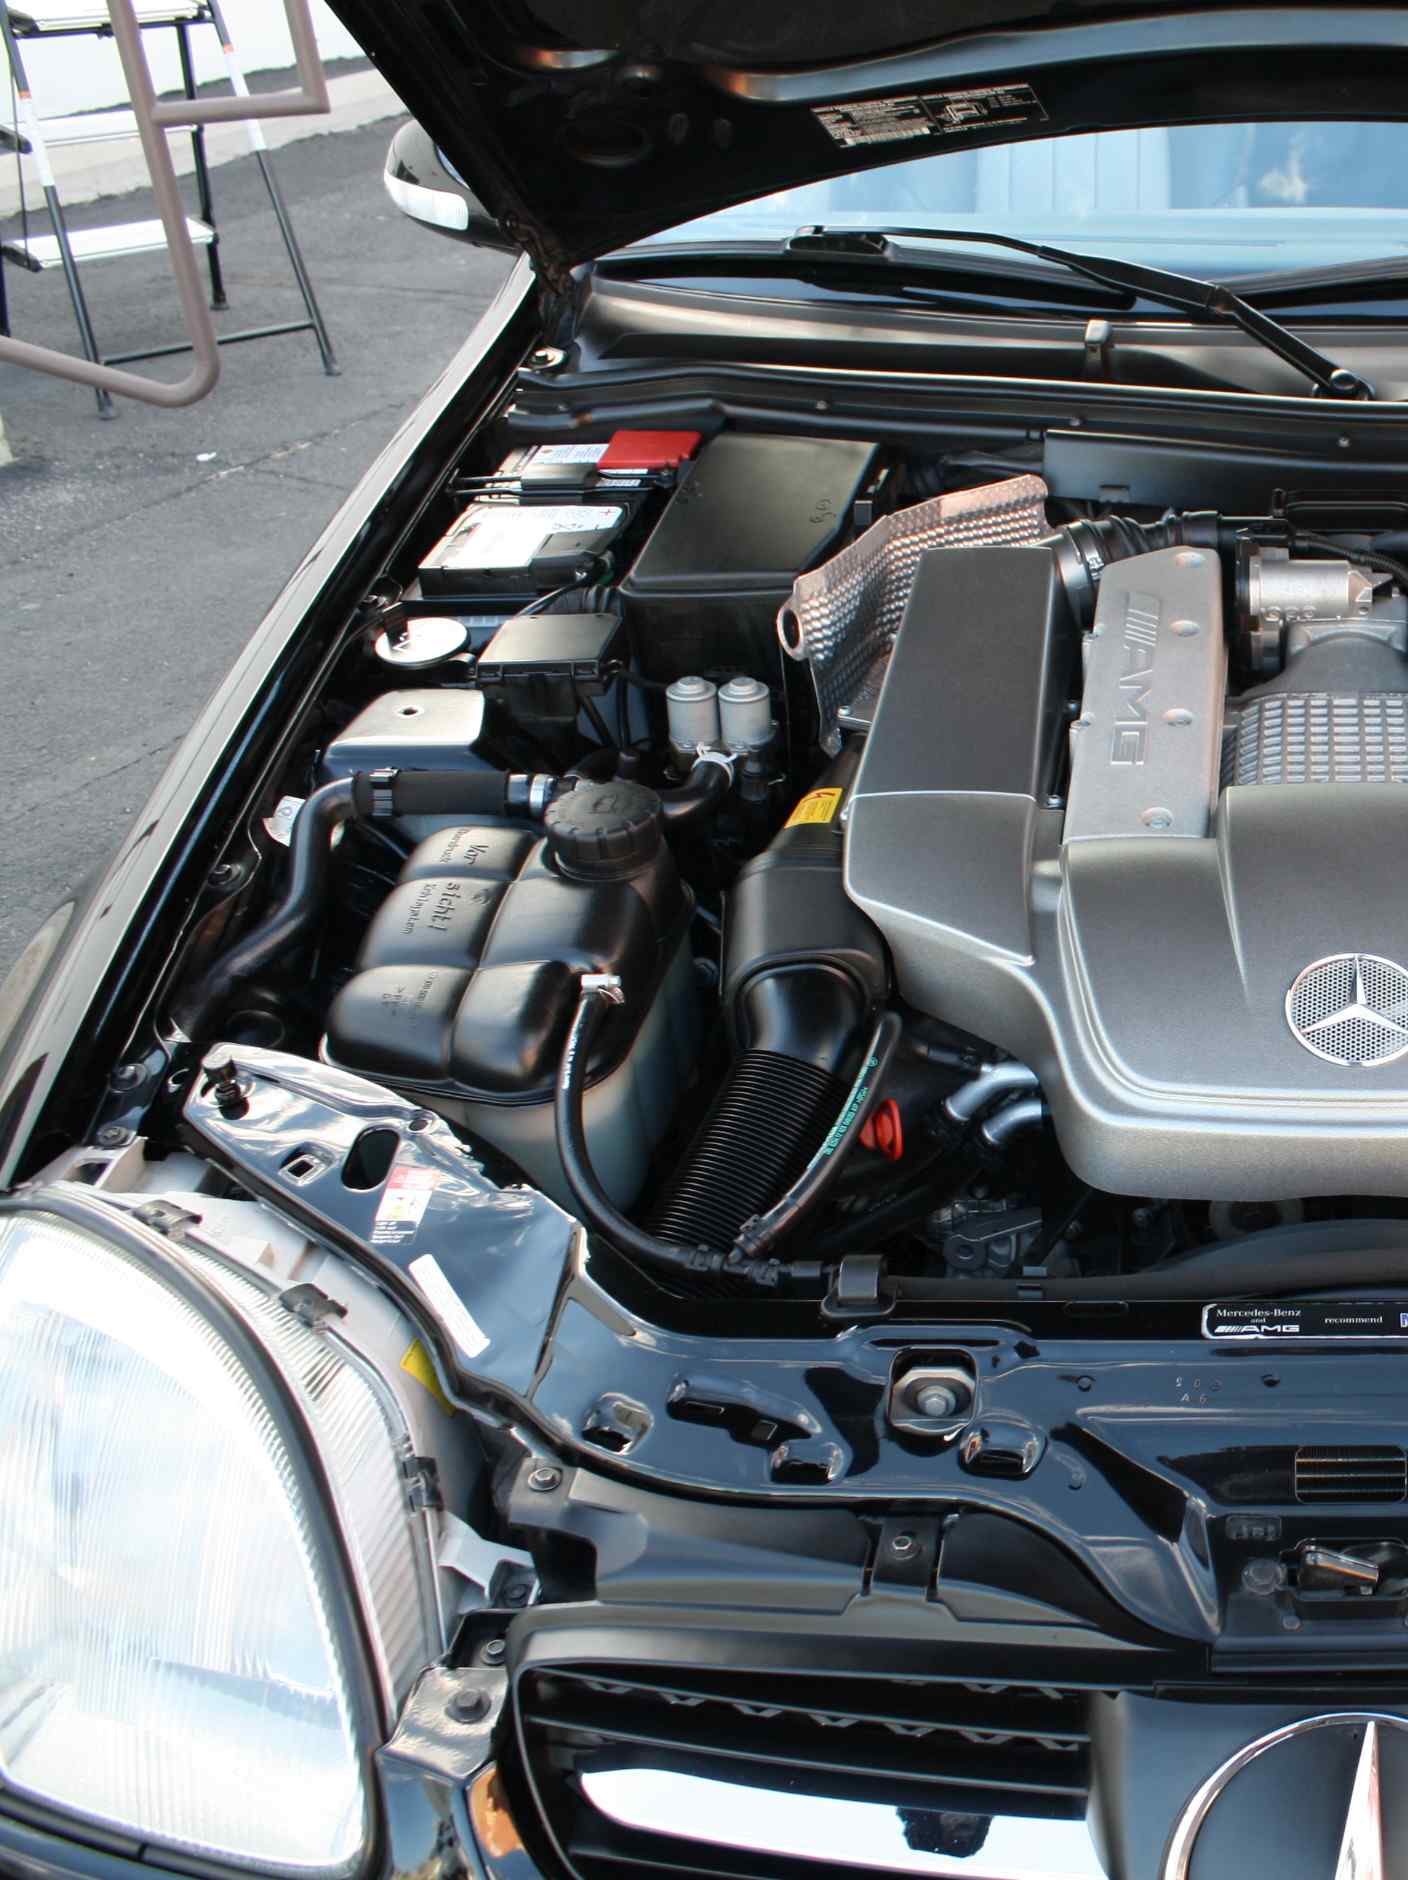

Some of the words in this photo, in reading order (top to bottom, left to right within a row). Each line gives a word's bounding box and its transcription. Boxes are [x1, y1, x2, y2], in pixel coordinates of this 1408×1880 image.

[1109, 638, 1155, 766] AMG
[1216, 1308, 1301, 1318] Mercedes-Benz
[1324, 1316, 1383, 1324] recommend
[1236, 1325, 1299, 1333] AMG
